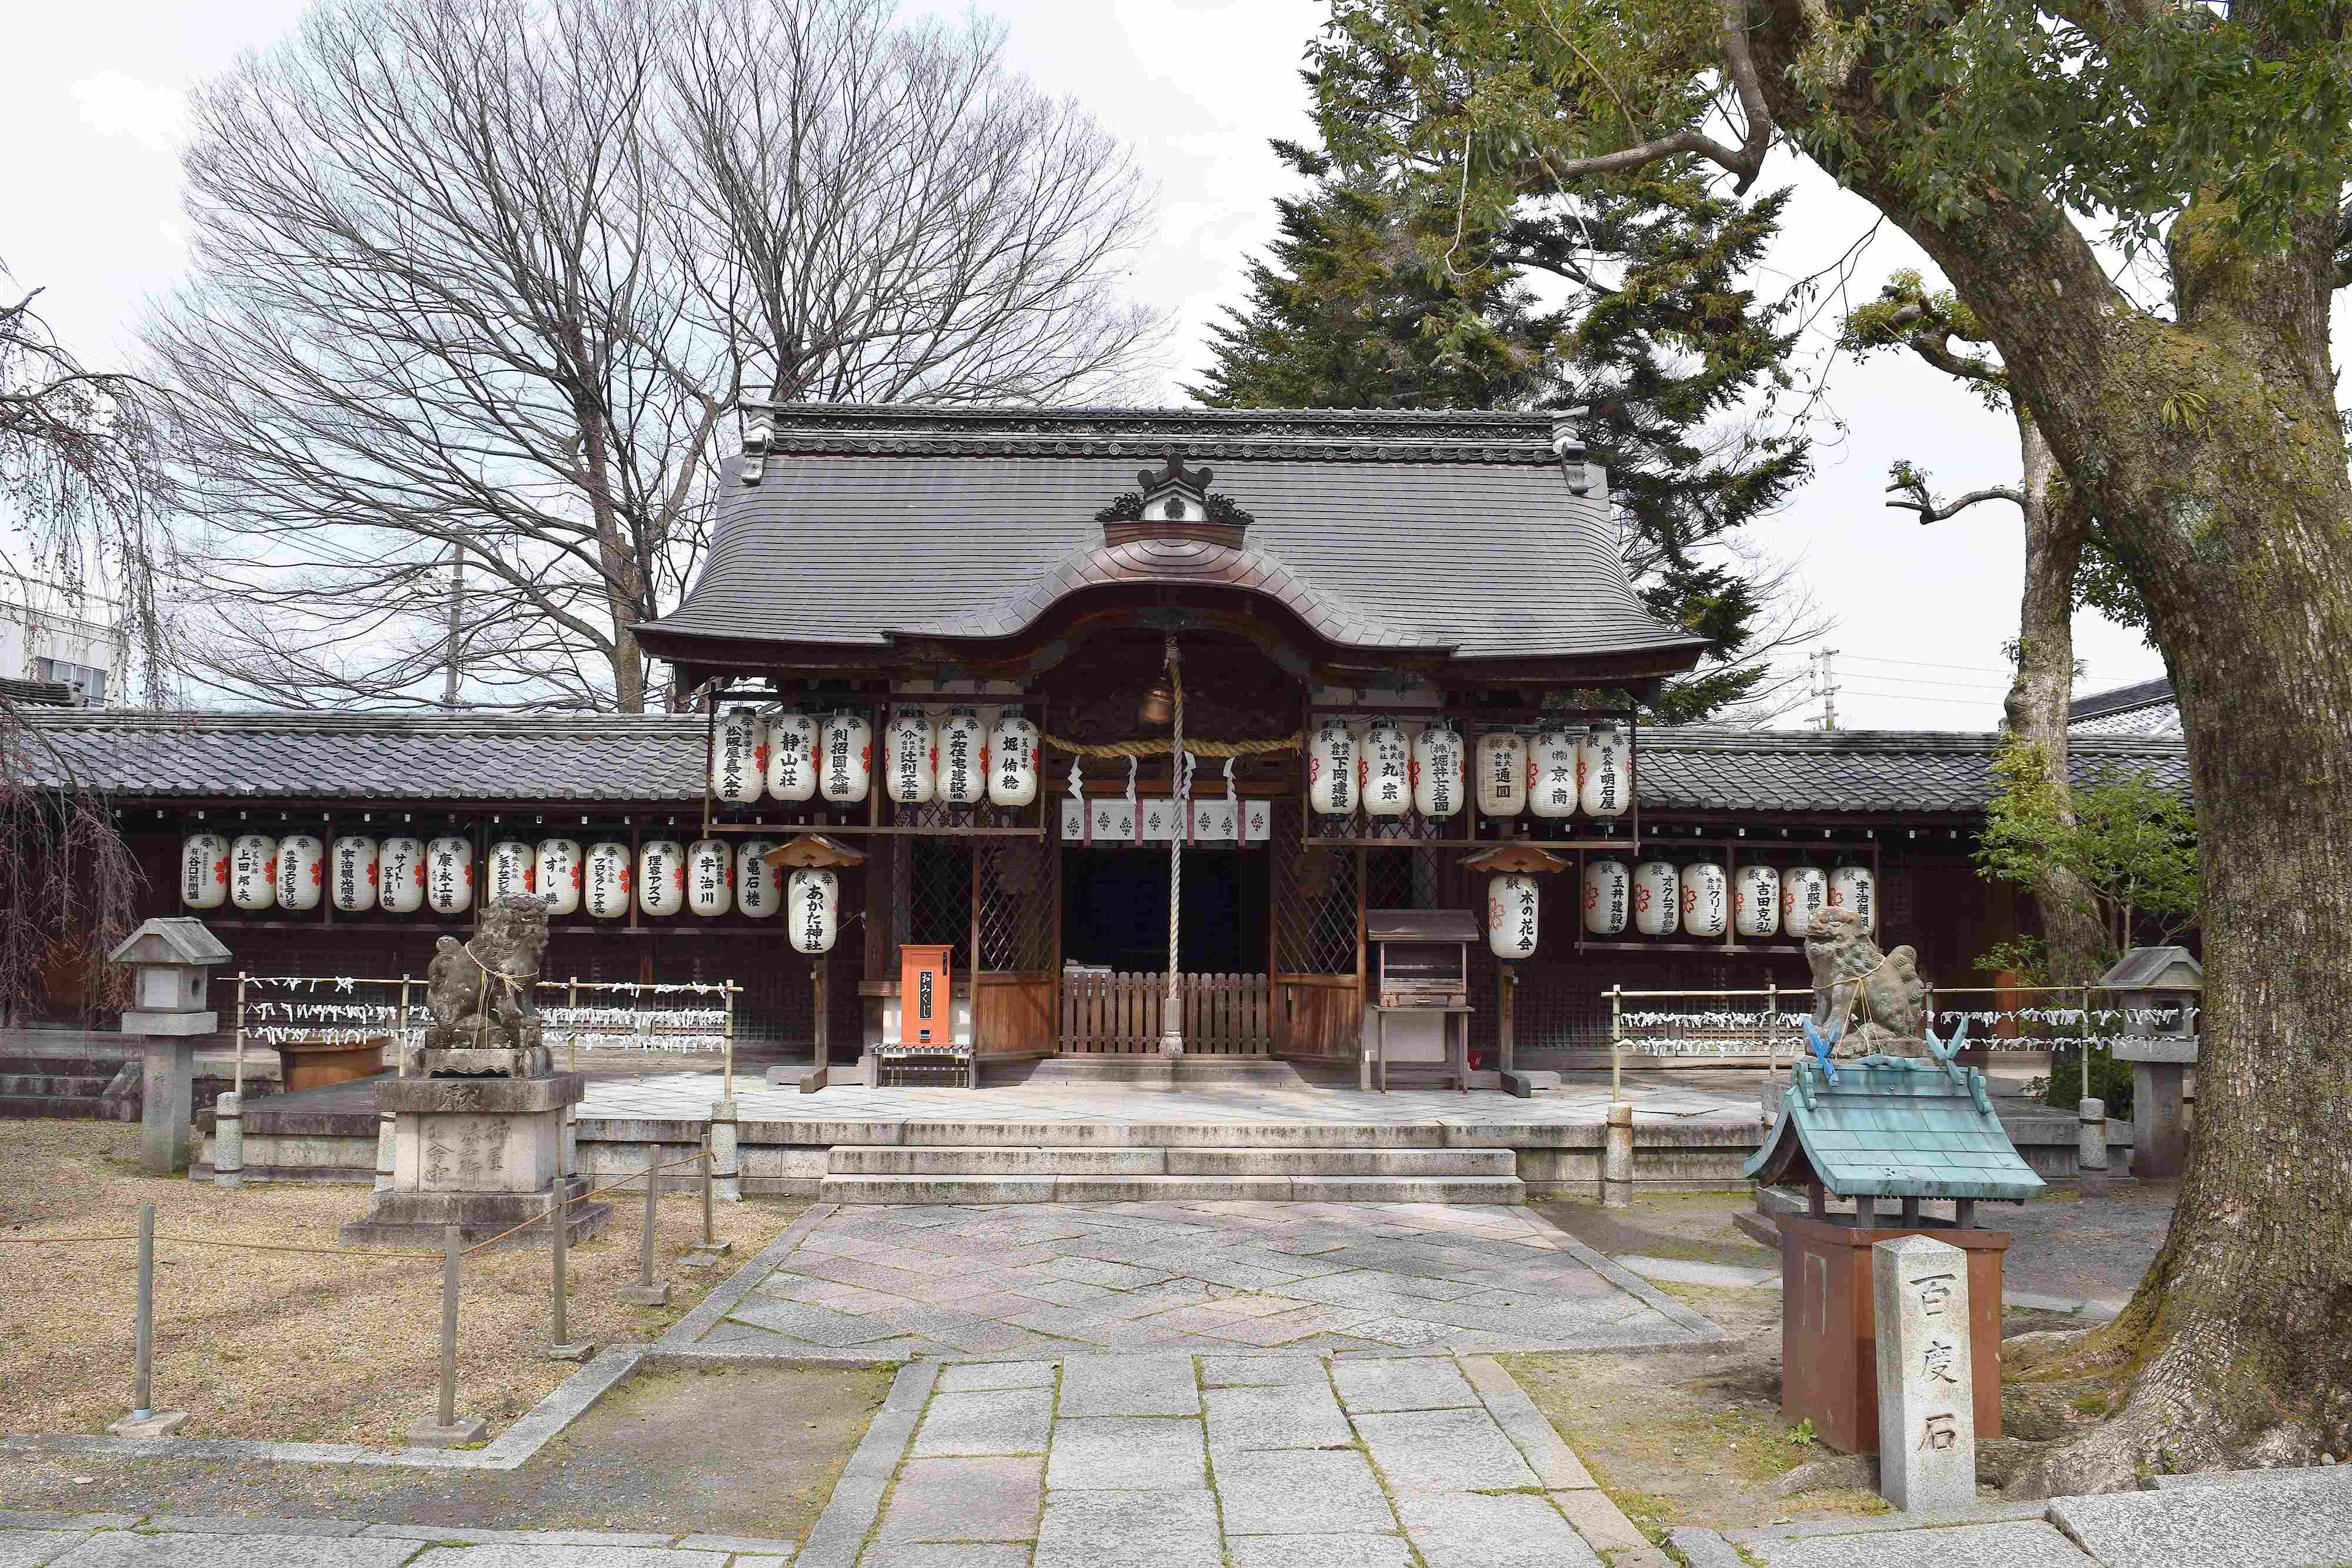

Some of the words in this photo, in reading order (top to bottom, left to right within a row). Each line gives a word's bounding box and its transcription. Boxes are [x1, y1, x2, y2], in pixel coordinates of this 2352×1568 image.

[740, 717, 755, 727] 奉
[797, 718, 810, 731] 奉
[847, 718, 861, 731] 奉
[916, 720, 929, 733] 奉
[965, 718, 978, 731] 奉
[1017, 721, 1030, 733] 奉
[1346, 733, 1357, 743] 奉
[1394, 732, 1406, 743] 奉
[1445, 733, 1459, 744] 奉
[1563, 735, 1576, 747] 奉
[1612, 735, 1624, 747] 奉
[1507, 739, 1518, 750] 奉
[780, 731, 800, 787] 静山荘
[901, 750, 918, 800] 辻利一本店
[1381, 762, 1398, 800] 丸宗
[1331, 756, 1348, 808] 下岡建設
[200, 837, 215, 848] 奉
[249, 838, 263, 849] 奉
[296, 838, 309, 849] 奉
[353, 838, 365, 849] 奉
[400, 841, 413, 852] 奉
[450, 841, 463, 852] 奉
[557, 842, 569, 853] 奉
[712, 842, 724, 854] 奉
[606, 847, 617, 857] 奉
[660, 844, 673, 855] 奉
[238, 849, 251, 901] 上田邦夫
[395, 854, 407, 889] サイトー
[1766, 870, 1776, 881] 奉
[545, 857, 559, 904] すし勝
[648, 855, 662, 907] 理容アズマ
[700, 857, 715, 904] 宇治川
[746, 858, 760, 907] 亀石楼
[822, 874, 833, 885] 奉
[383, 867, 395, 907] 写真館
[1708, 890, 1722, 932] クリーンズ
[1756, 881, 1770, 932] 吉田克弘
[804, 884, 823, 950] あがた神社
[1516, 890, 1534, 950] 木の花会
[921, 972, 931, 1017] おみくじ
[1910, 1273, 1959, 1453] 百度石
